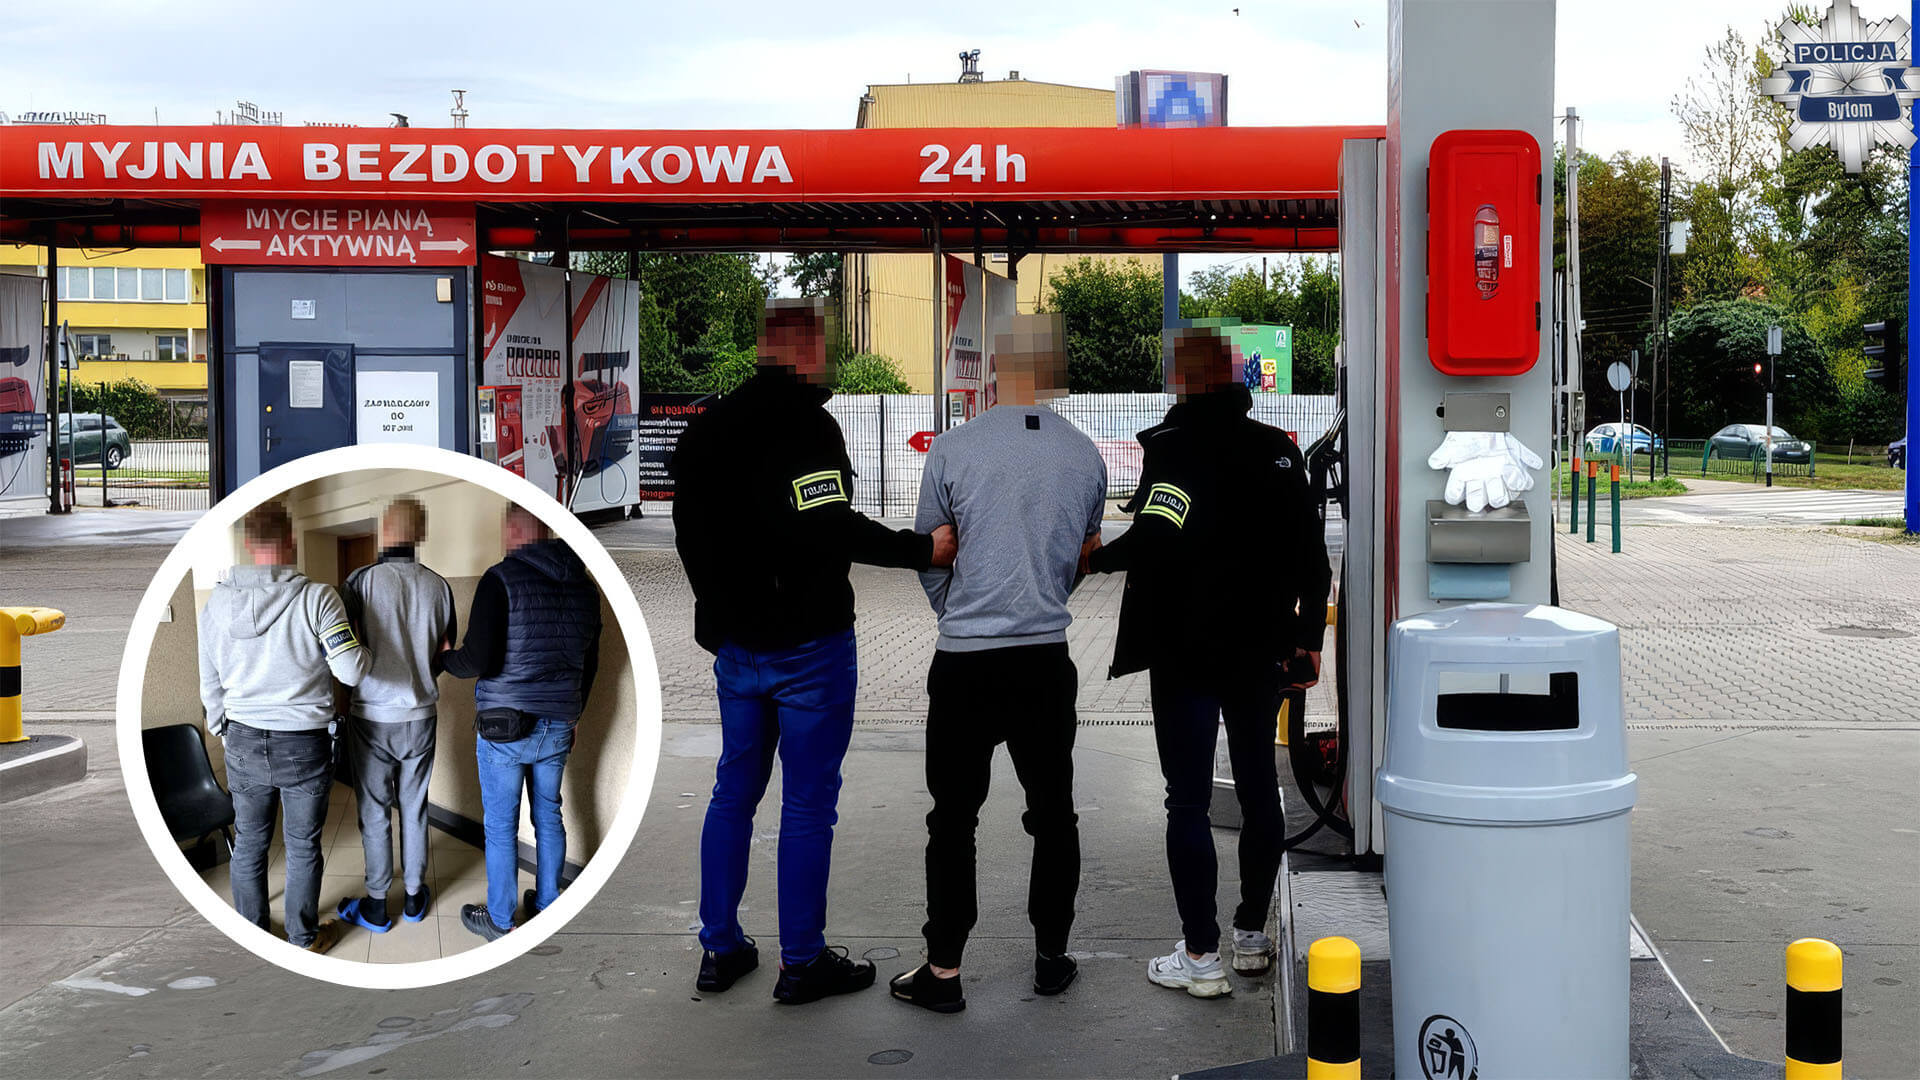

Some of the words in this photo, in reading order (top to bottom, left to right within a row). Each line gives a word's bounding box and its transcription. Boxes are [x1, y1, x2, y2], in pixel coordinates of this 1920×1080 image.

[38, 141, 272, 180] MYJNIA
[303, 143, 794, 184] BEZDOTYKOWA
[245, 208, 338, 231] MYCIE
[347, 209, 434, 237] PIANĄ
[265, 233, 417, 264] AKTYWNĄ
